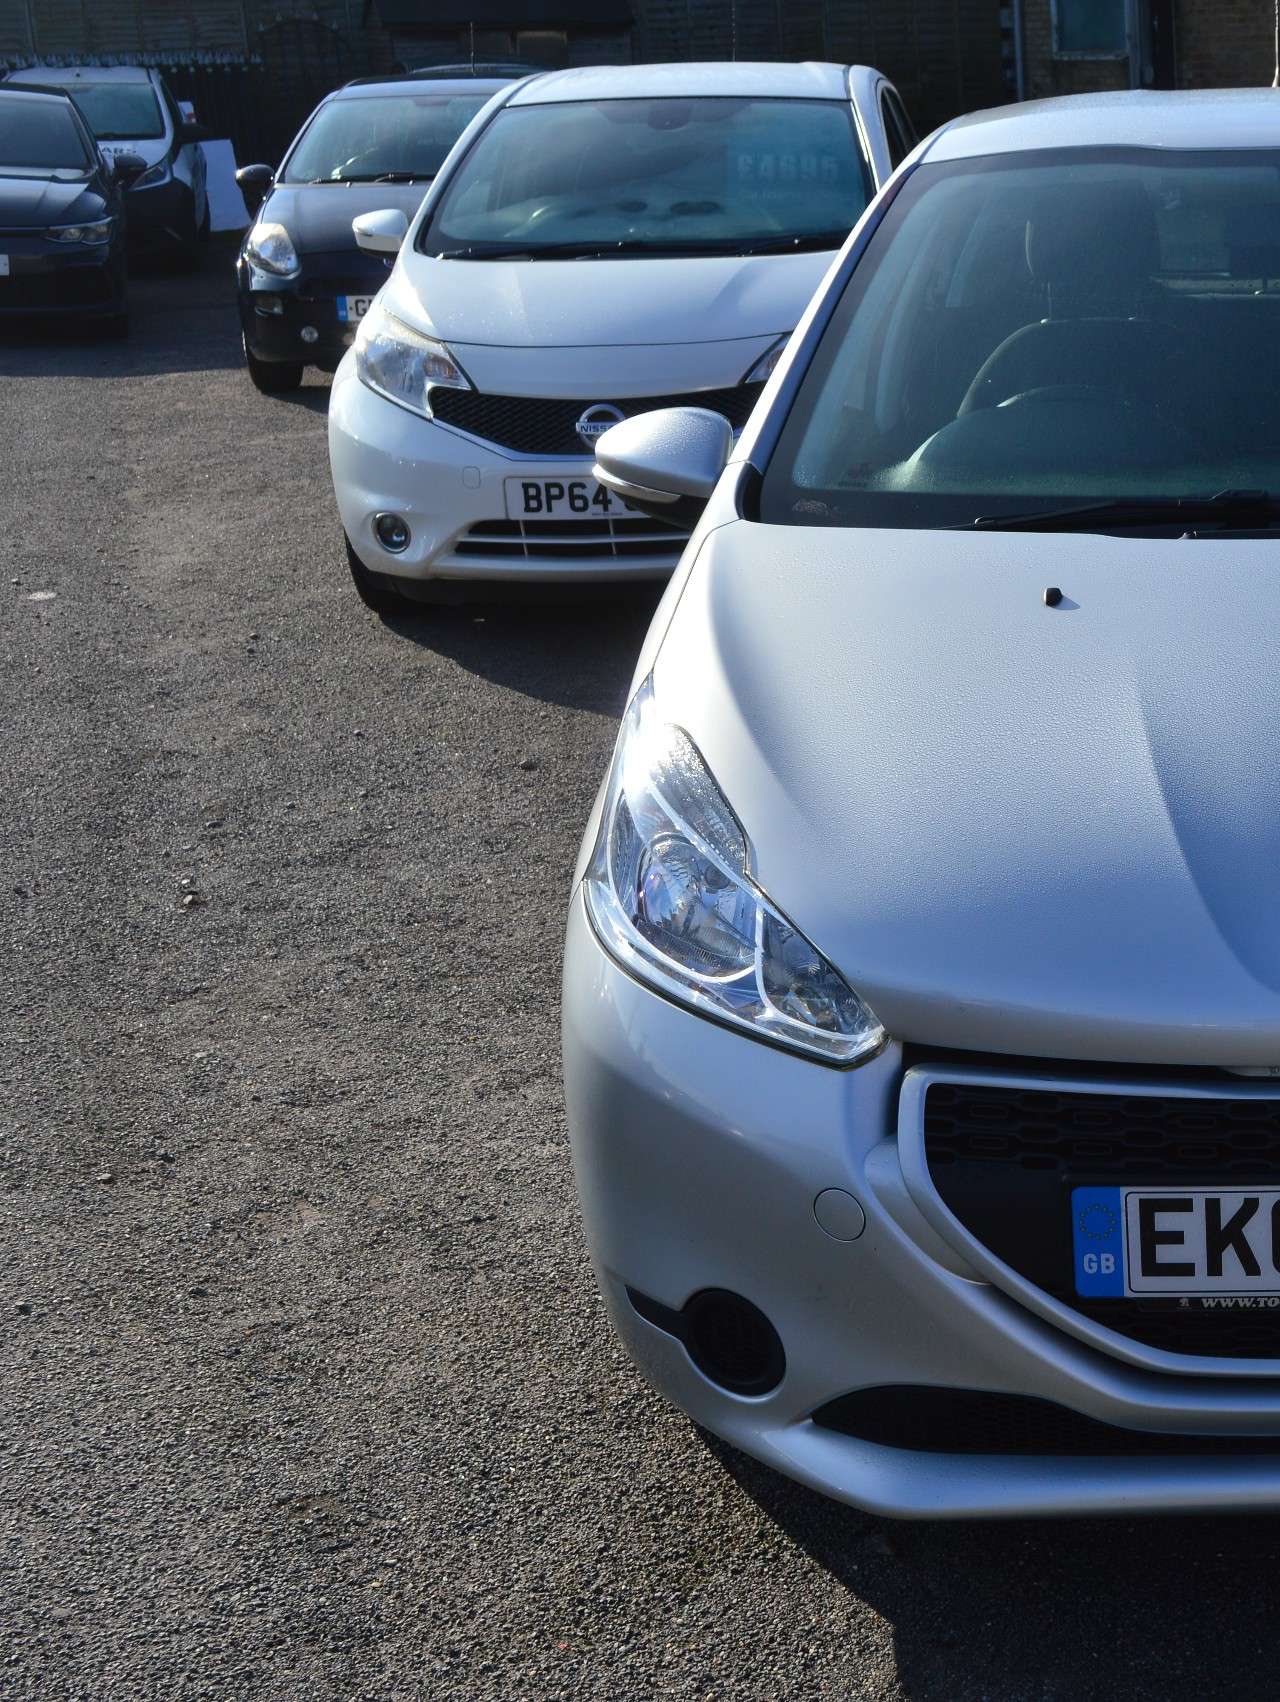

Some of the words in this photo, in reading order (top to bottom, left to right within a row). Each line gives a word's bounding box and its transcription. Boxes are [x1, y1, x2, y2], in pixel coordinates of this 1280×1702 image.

[580, 423, 613, 433] NISS
[521, 482, 612, 513] BP64
[1083, 1253, 1116, 1275] GB
